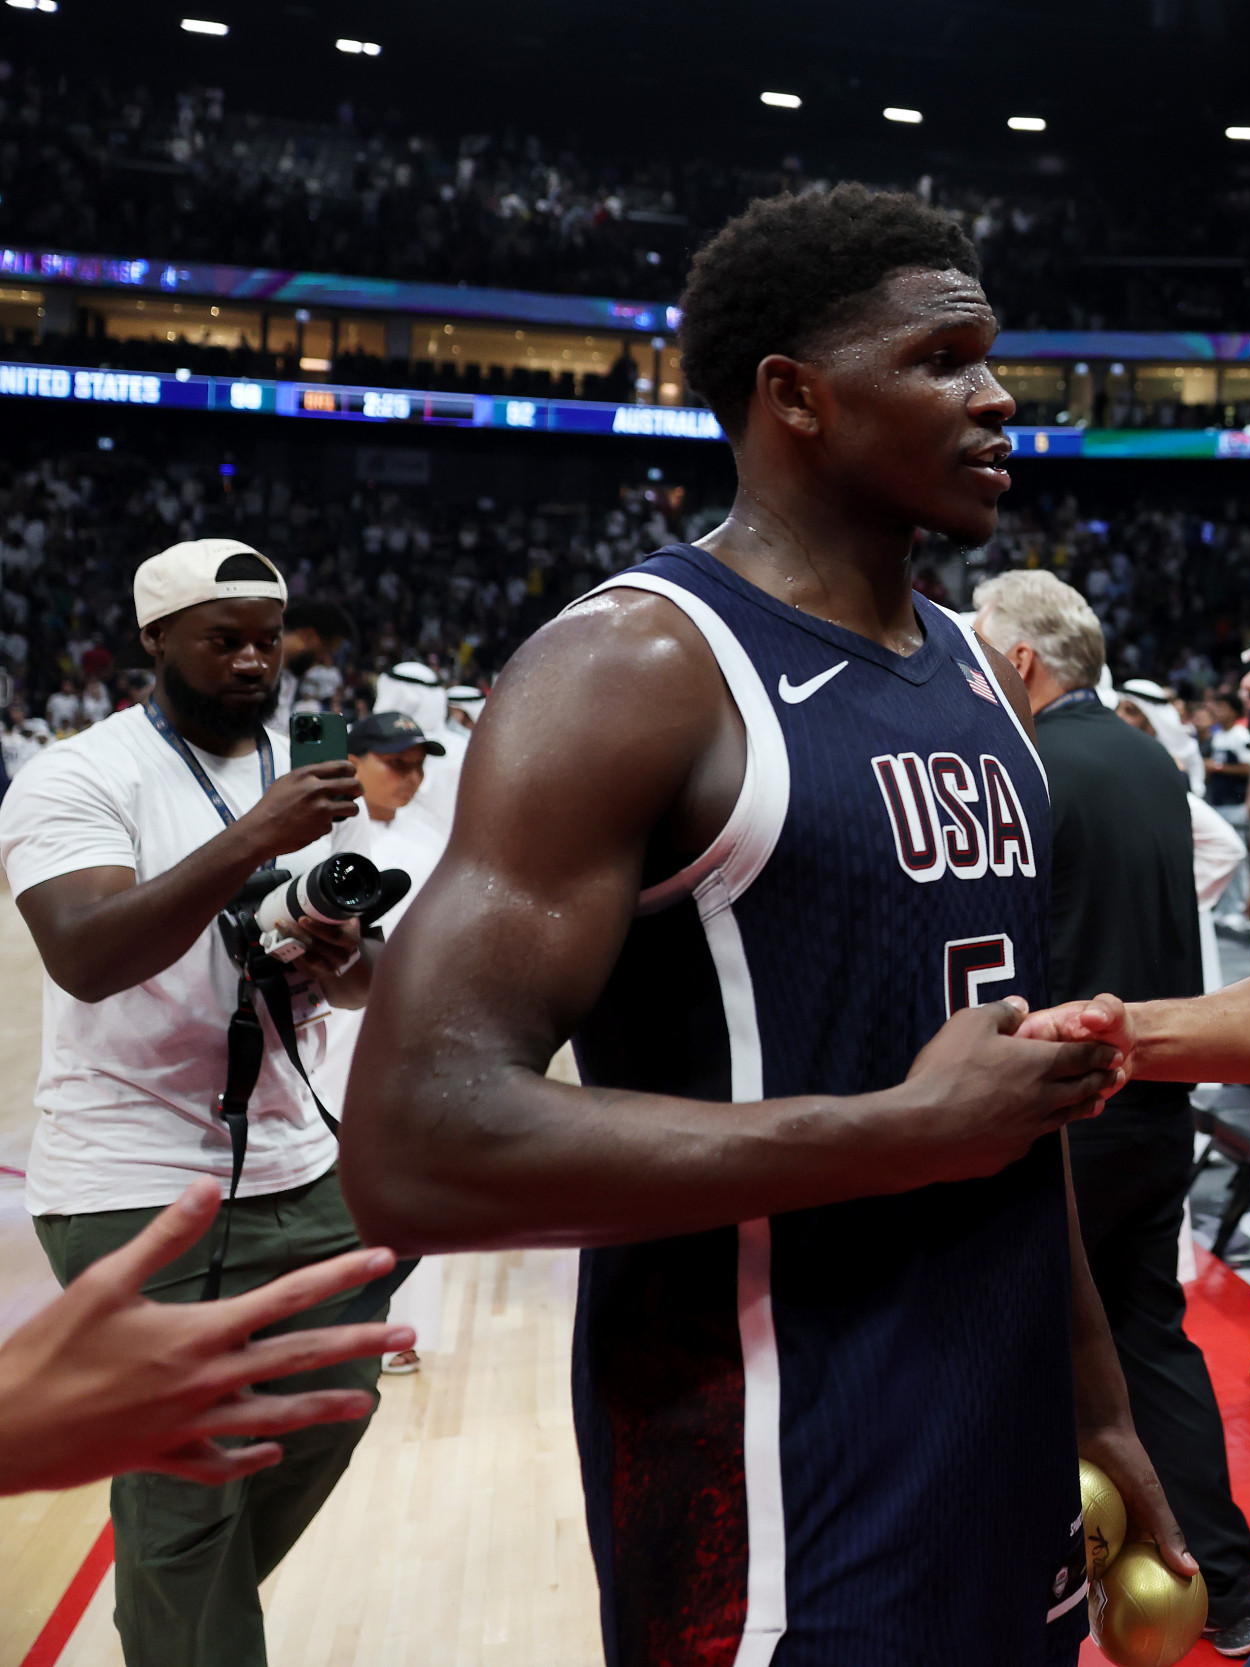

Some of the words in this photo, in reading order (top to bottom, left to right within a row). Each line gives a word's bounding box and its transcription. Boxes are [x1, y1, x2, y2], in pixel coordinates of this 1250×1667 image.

[73, 370, 161, 404] STATES
[612, 406, 724, 439] AUSTRALIA
[871, 752, 1036, 883] USA
